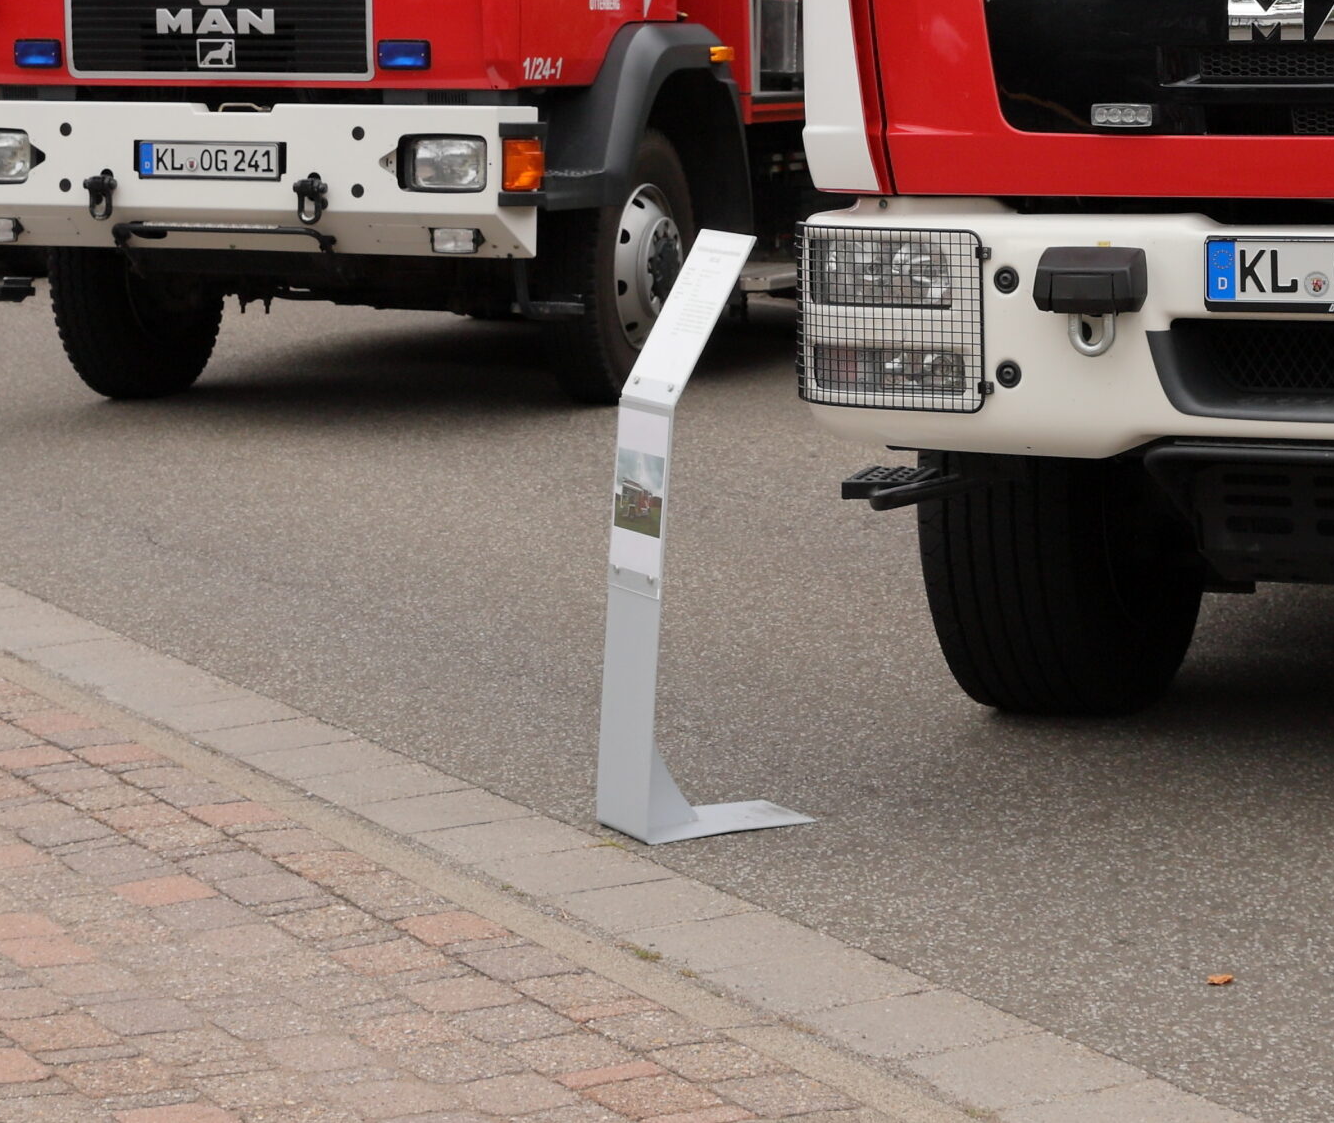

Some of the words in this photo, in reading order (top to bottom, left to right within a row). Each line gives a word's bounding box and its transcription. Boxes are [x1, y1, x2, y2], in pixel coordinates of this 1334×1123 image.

[155, 8, 275, 35] MAN
[523, 57, 563, 80] 1/24-1
[156, 148, 184, 171] KL
[200, 149, 228, 172] OG
[233, 149, 274, 173] 241
[1218, 277, 1228, 290] D
[1239, 249, 1298, 293] KL
